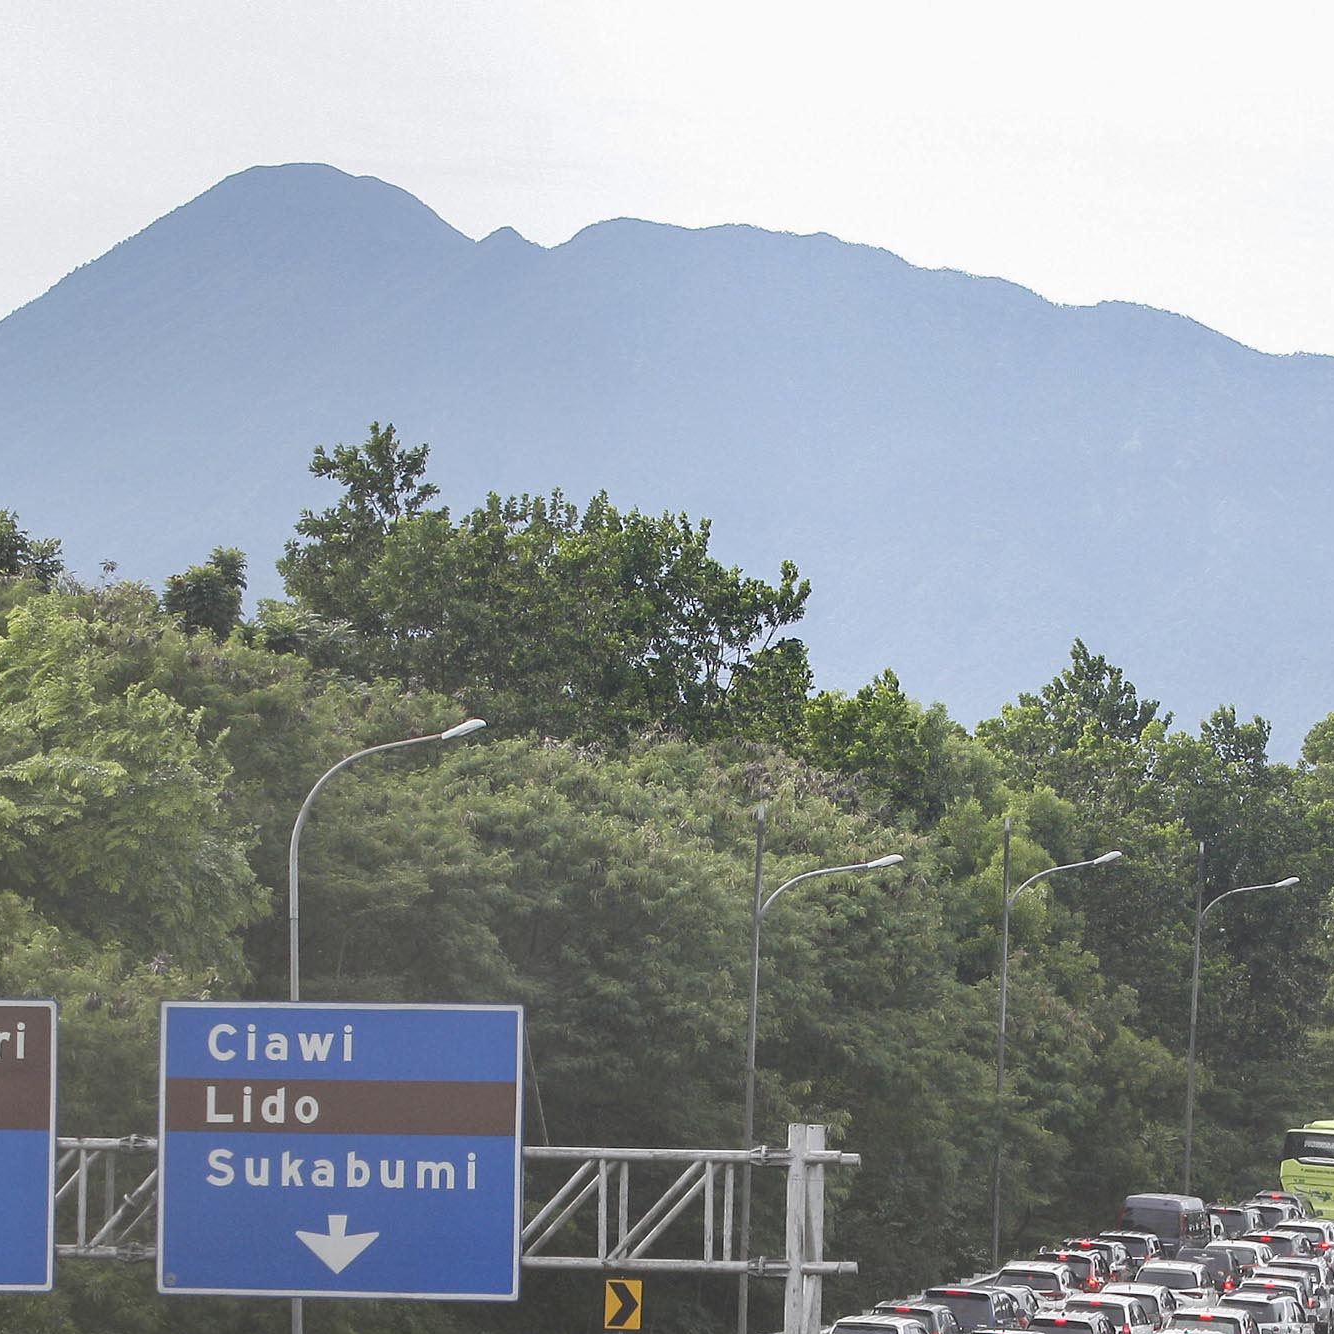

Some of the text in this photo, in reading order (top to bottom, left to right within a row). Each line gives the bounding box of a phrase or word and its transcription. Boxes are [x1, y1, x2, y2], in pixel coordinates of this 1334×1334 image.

[207, 1023, 354, 1062] Ciawi
[206, 1086, 319, 1124] Lido
[206, 1148, 476, 1190] Sukabumi
